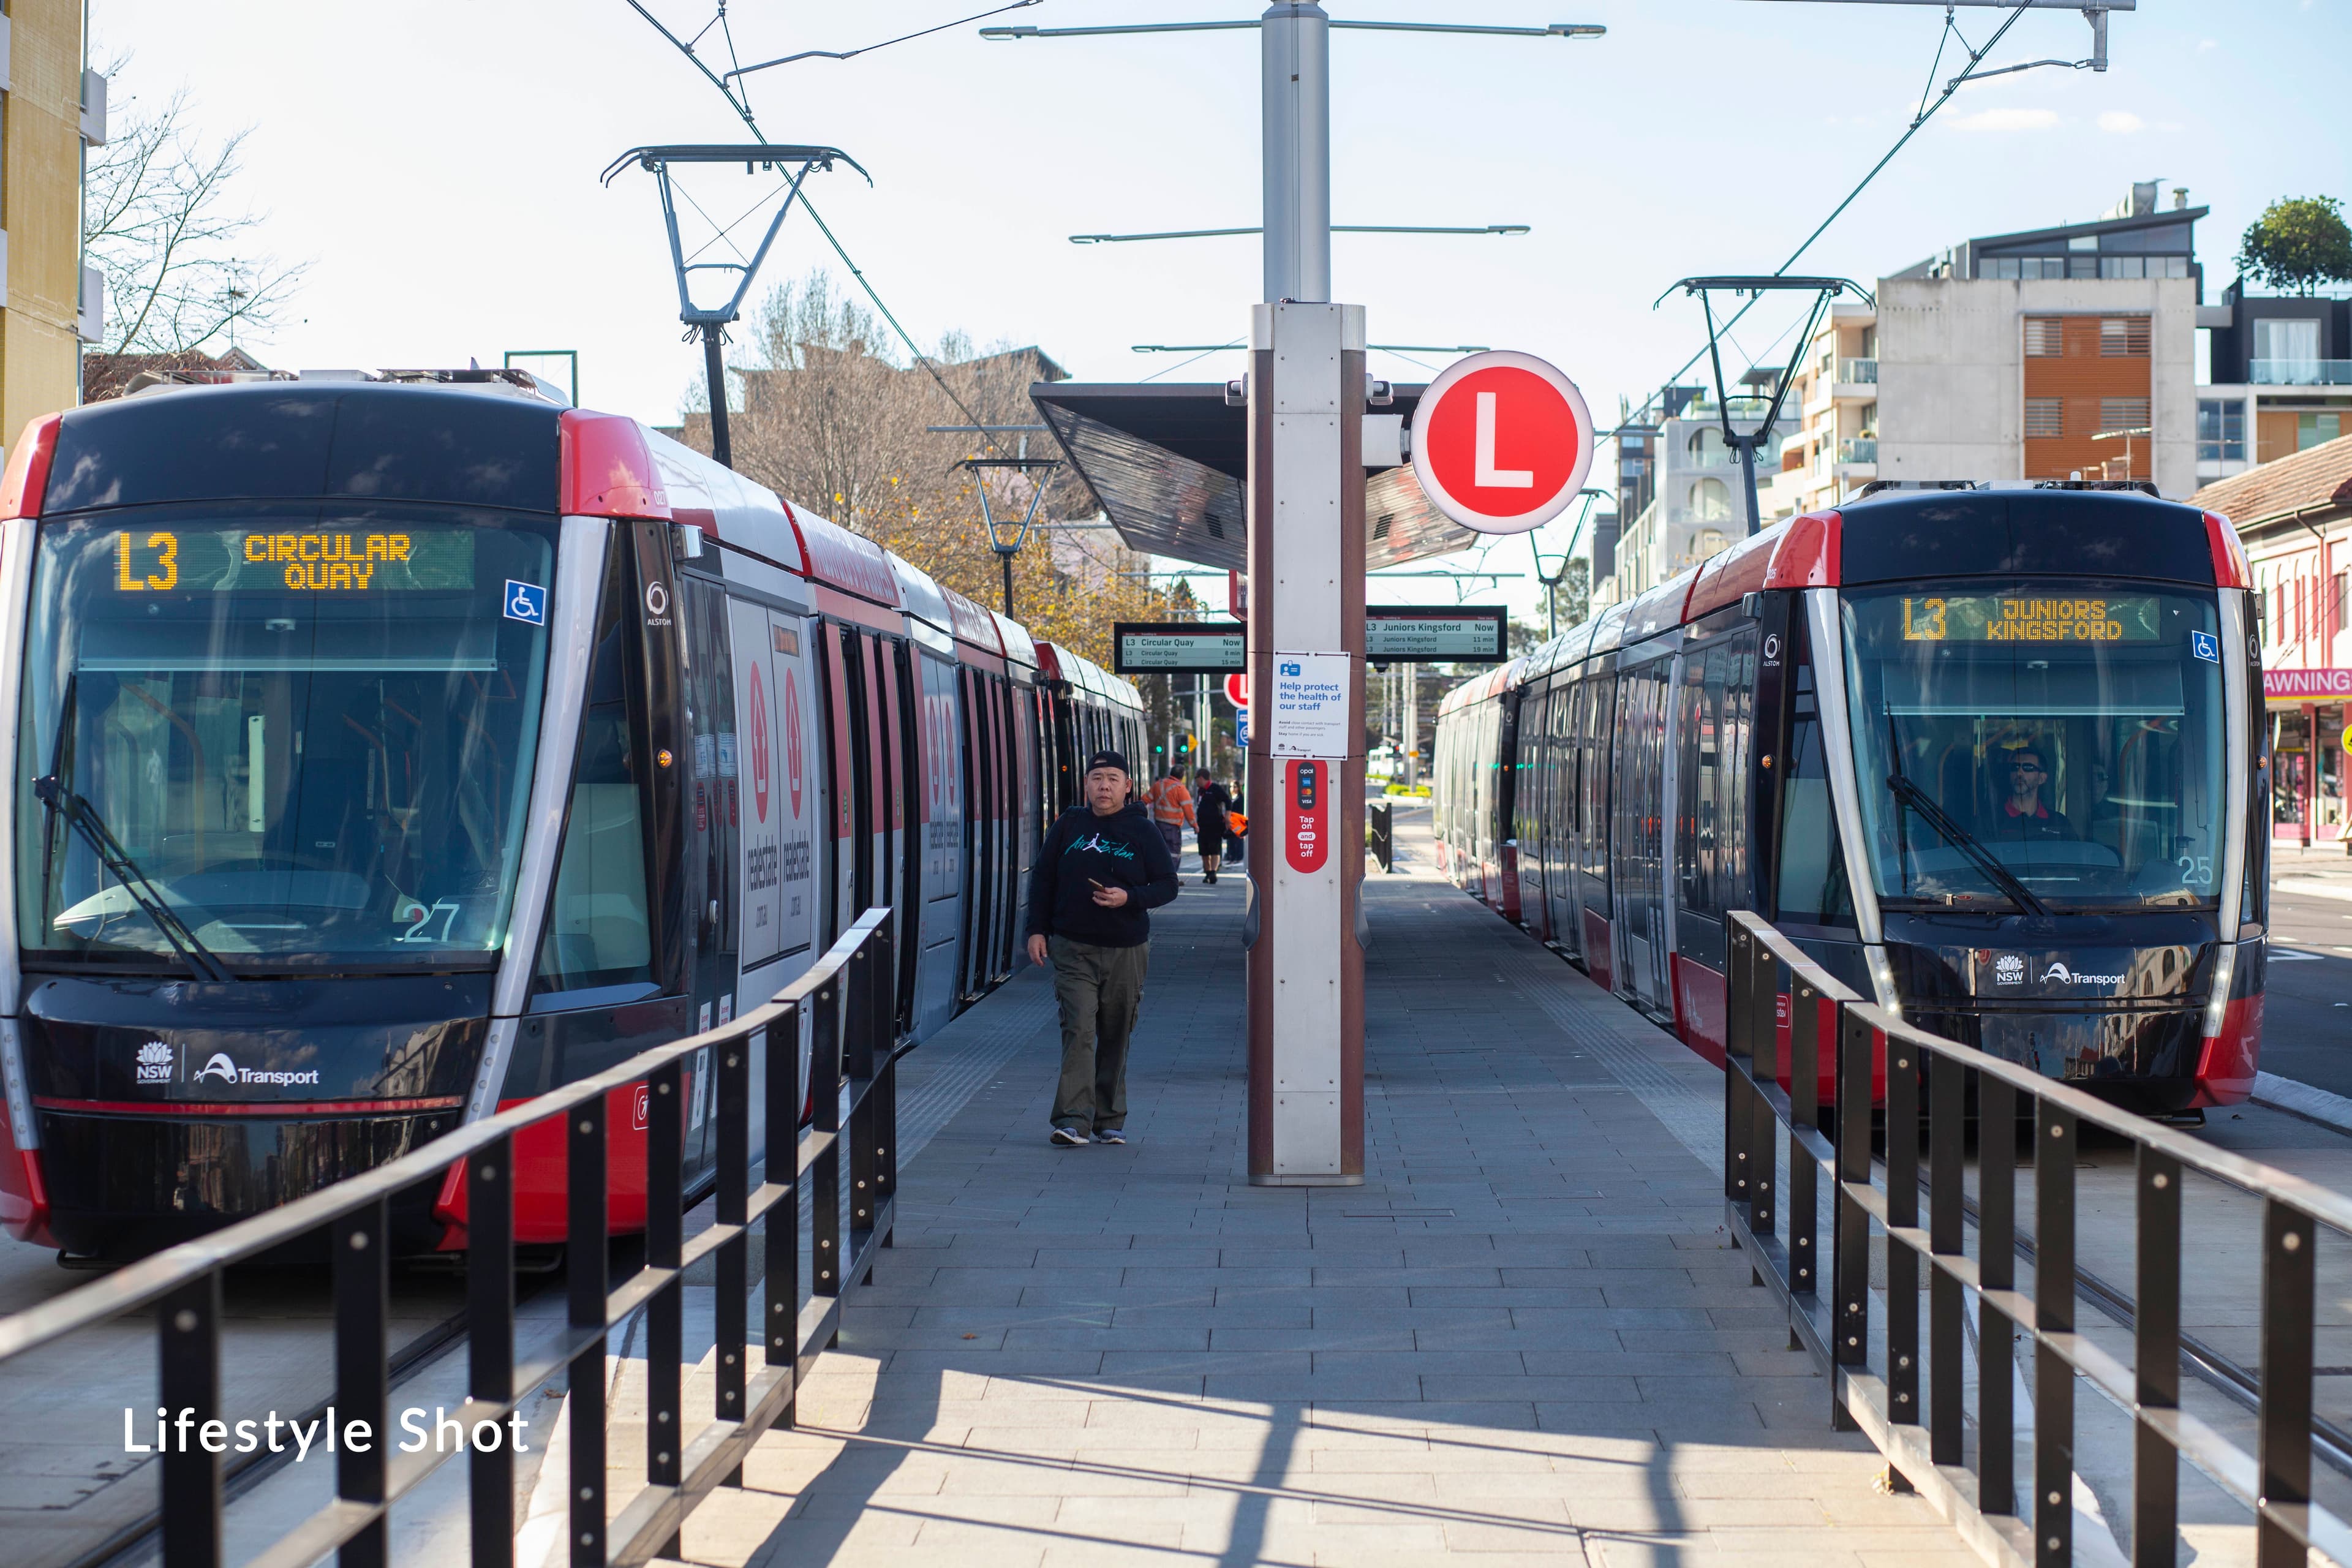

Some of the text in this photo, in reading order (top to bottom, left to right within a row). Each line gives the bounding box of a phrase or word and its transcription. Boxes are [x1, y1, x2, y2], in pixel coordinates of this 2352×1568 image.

[1475, 392, 1534, 488] L
[654, 491, 666, 505] 027
[245, 534, 410, 560] CIRCULAR
[119, 532, 177, 590] L3
[285, 563, 373, 589] QUAY
[1904, 598, 1946, 640] L3
[2003, 600, 2106, 619] JUNIORS
[1419, 623, 1461, 633] Kingsford
[1987, 620, 2122, 640] KINGSFORD
[1280, 682, 1339, 692] Help protect
[2264, 671, 2352, 692] AWNING
[1299, 816, 1314, 824] Tap
[748, 834, 777, 892] realestate
[783, 829, 810, 883] realestate
[2178, 856, 2213, 884] 25
[402, 903, 459, 943] 27
[1996, 971, 2024, 982] NSW
[2071, 973, 2126, 986] Transport
[136, 1065, 172, 1079] NSW
[238, 1068, 319, 1087] Transport
